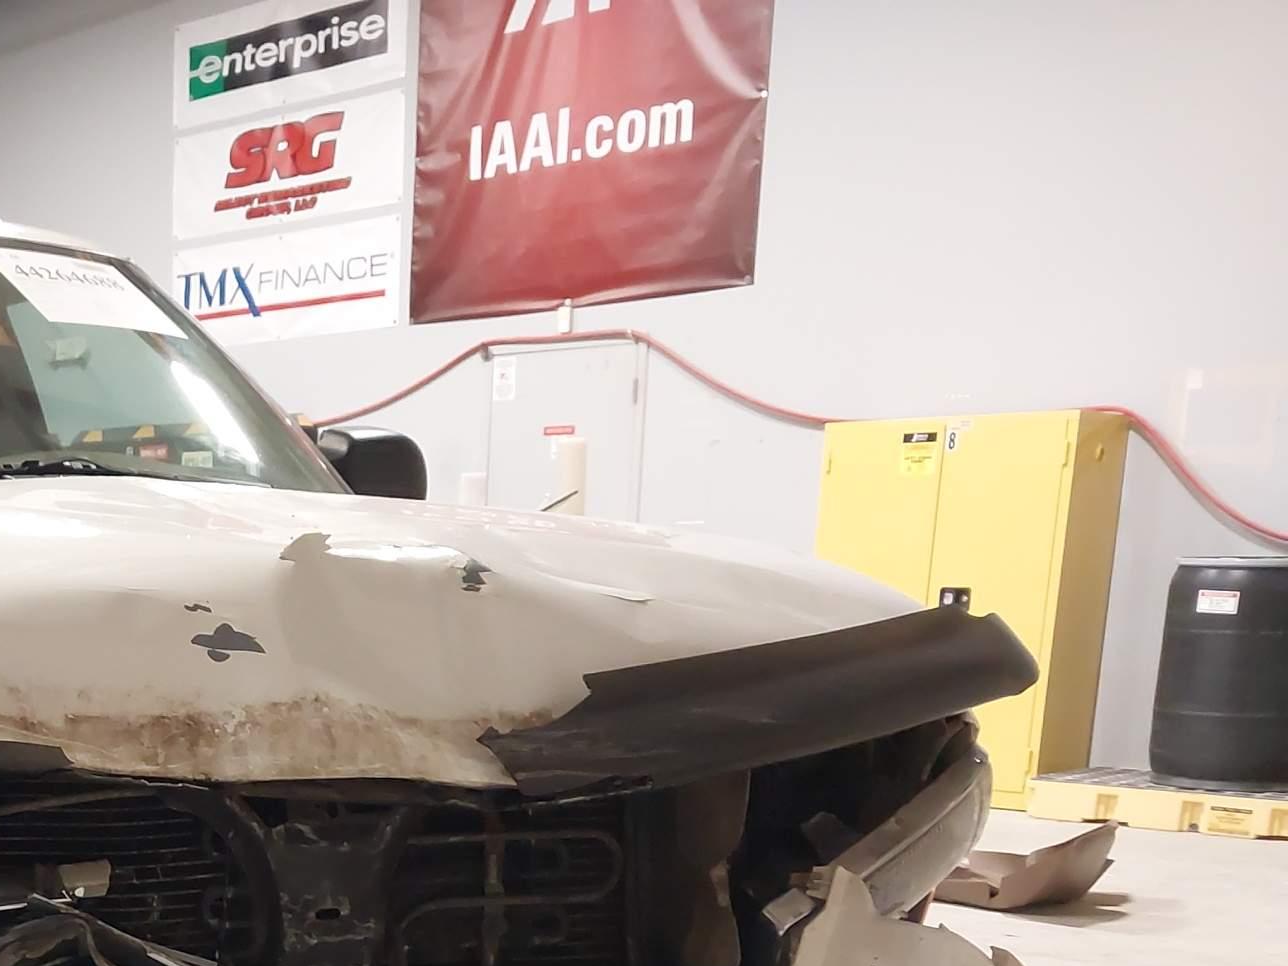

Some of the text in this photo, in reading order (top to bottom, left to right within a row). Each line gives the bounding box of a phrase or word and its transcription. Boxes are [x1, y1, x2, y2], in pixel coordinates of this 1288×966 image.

[190, 14, 385, 84] enterprise
[224, 111, 345, 189] SRG
[468, 98, 695, 182] IAAI.com
[176, 253, 388, 317] TMX FINANCE
[948, 431, 957, 450] 8
